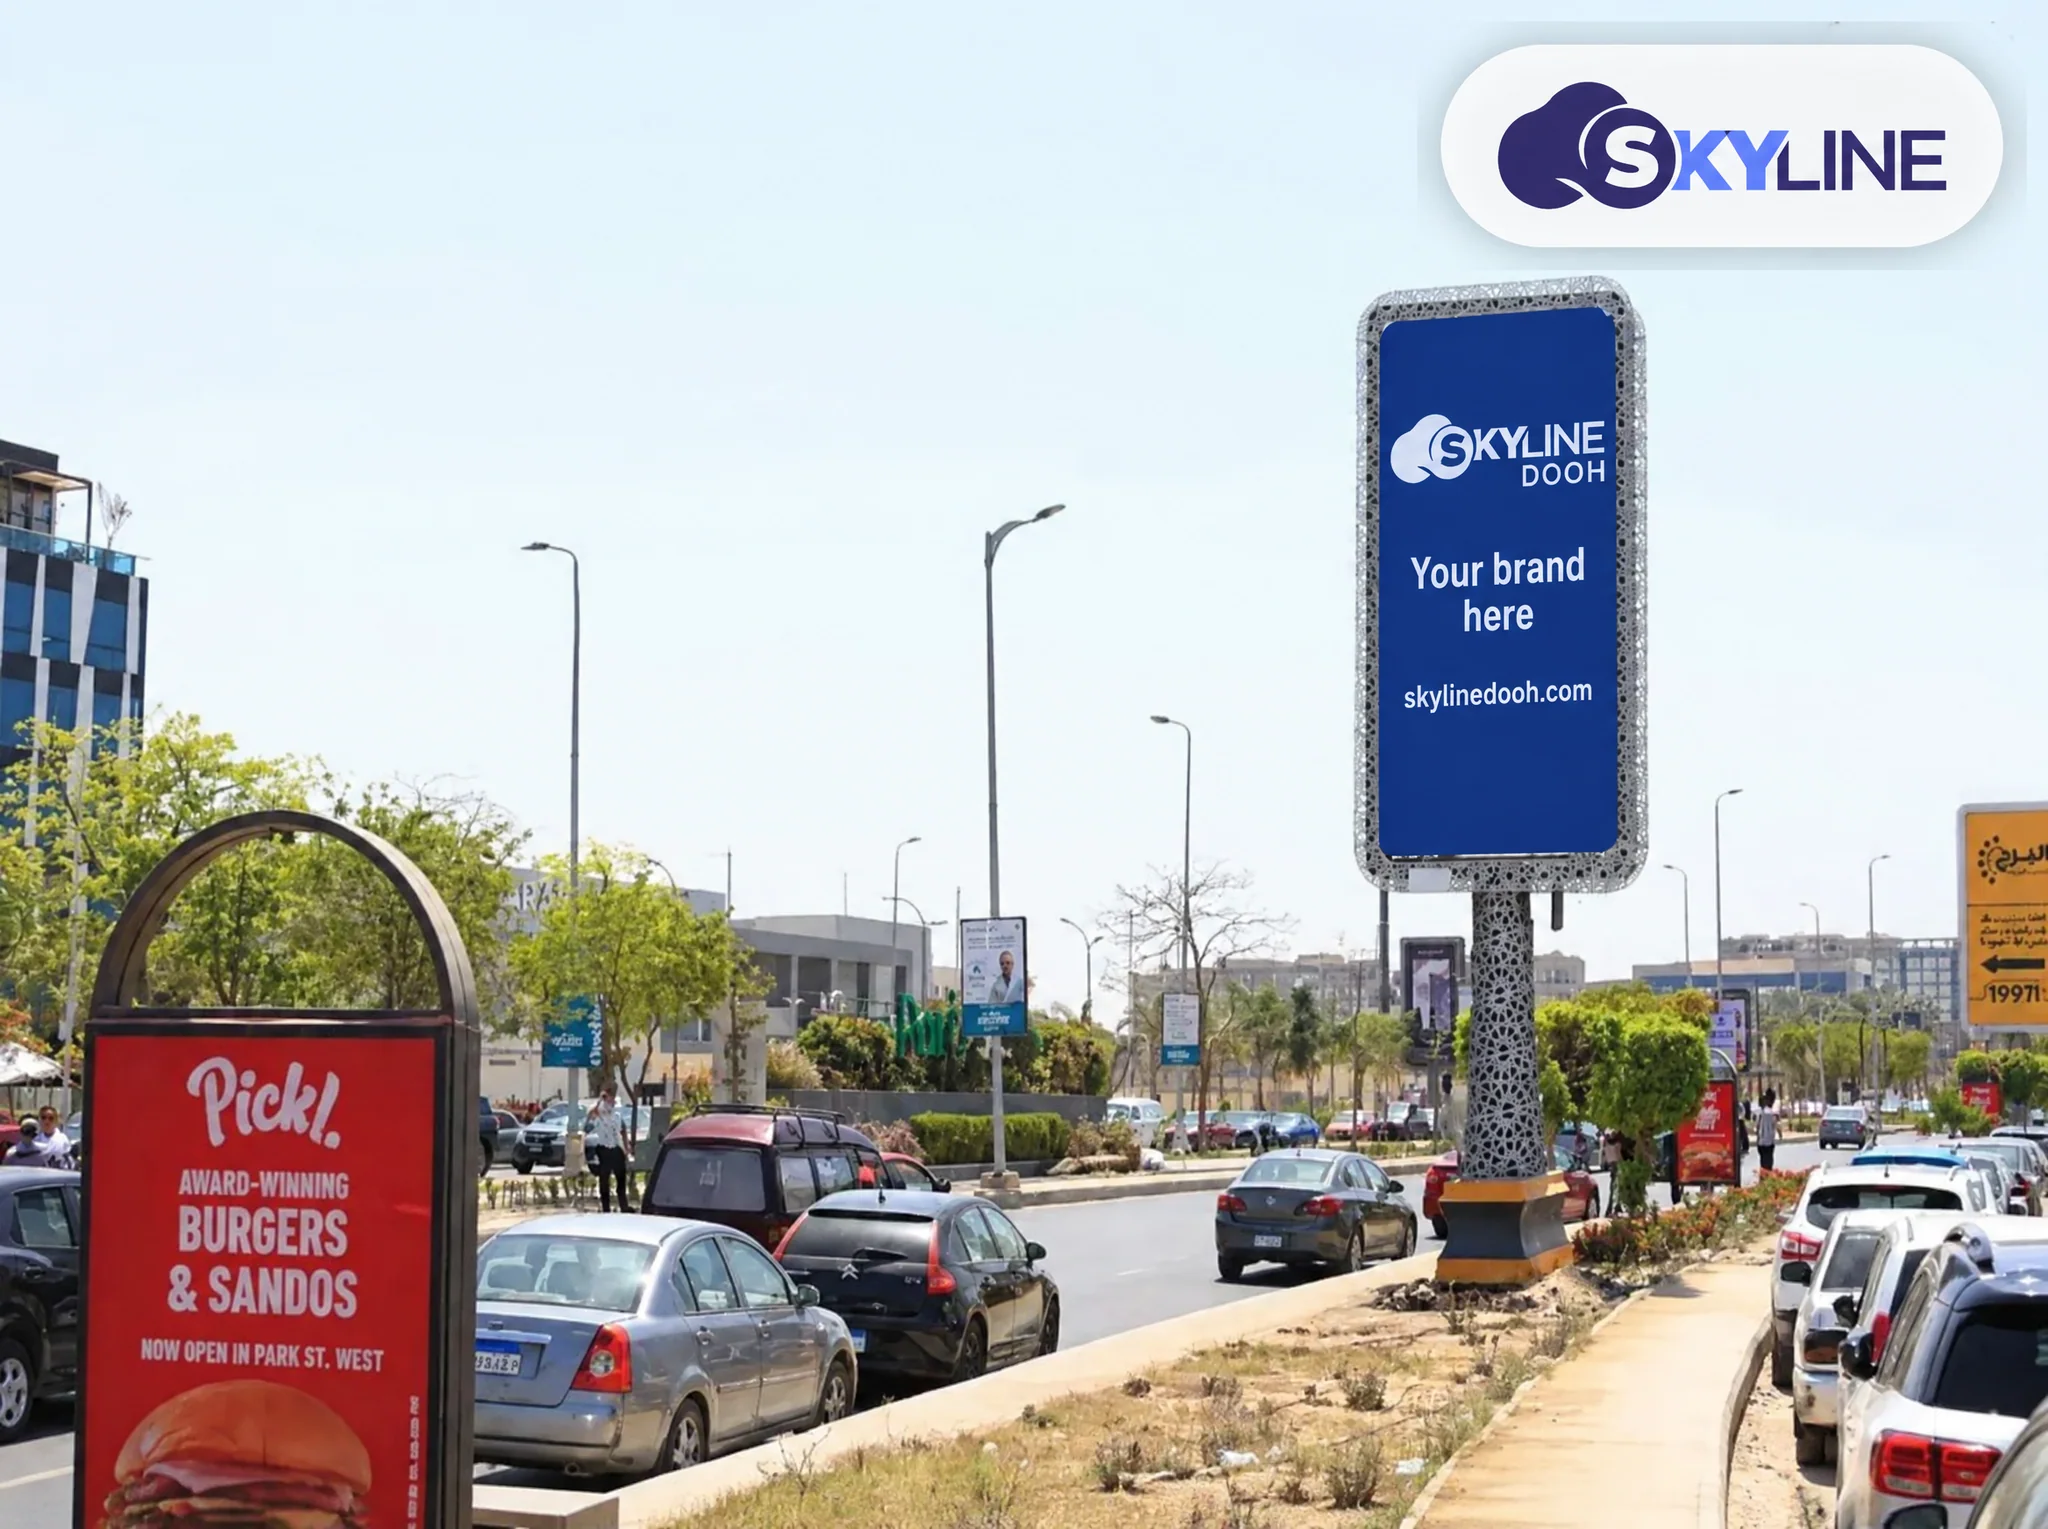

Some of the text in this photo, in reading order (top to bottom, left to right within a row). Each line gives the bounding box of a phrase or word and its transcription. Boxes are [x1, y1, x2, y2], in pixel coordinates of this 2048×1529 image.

[1440, 421, 1605, 467] SKYLINE
[1522, 459, 1606, 487] DOOH
[1410, 546, 1585, 590] Your brand
[1463, 598, 1534, 632] here
[1403, 679, 1593, 714] skylinedooh.com
[1988, 983, 2040, 1004] 19971
[178, 1168, 349, 1200] AWARD-WINNING
[178, 1205, 348, 1258] BURGERS
[167, 1264, 358, 1319] & SANDOS
[140, 1338, 385, 1373] NOW OPEN IN PARK ST. WEST
